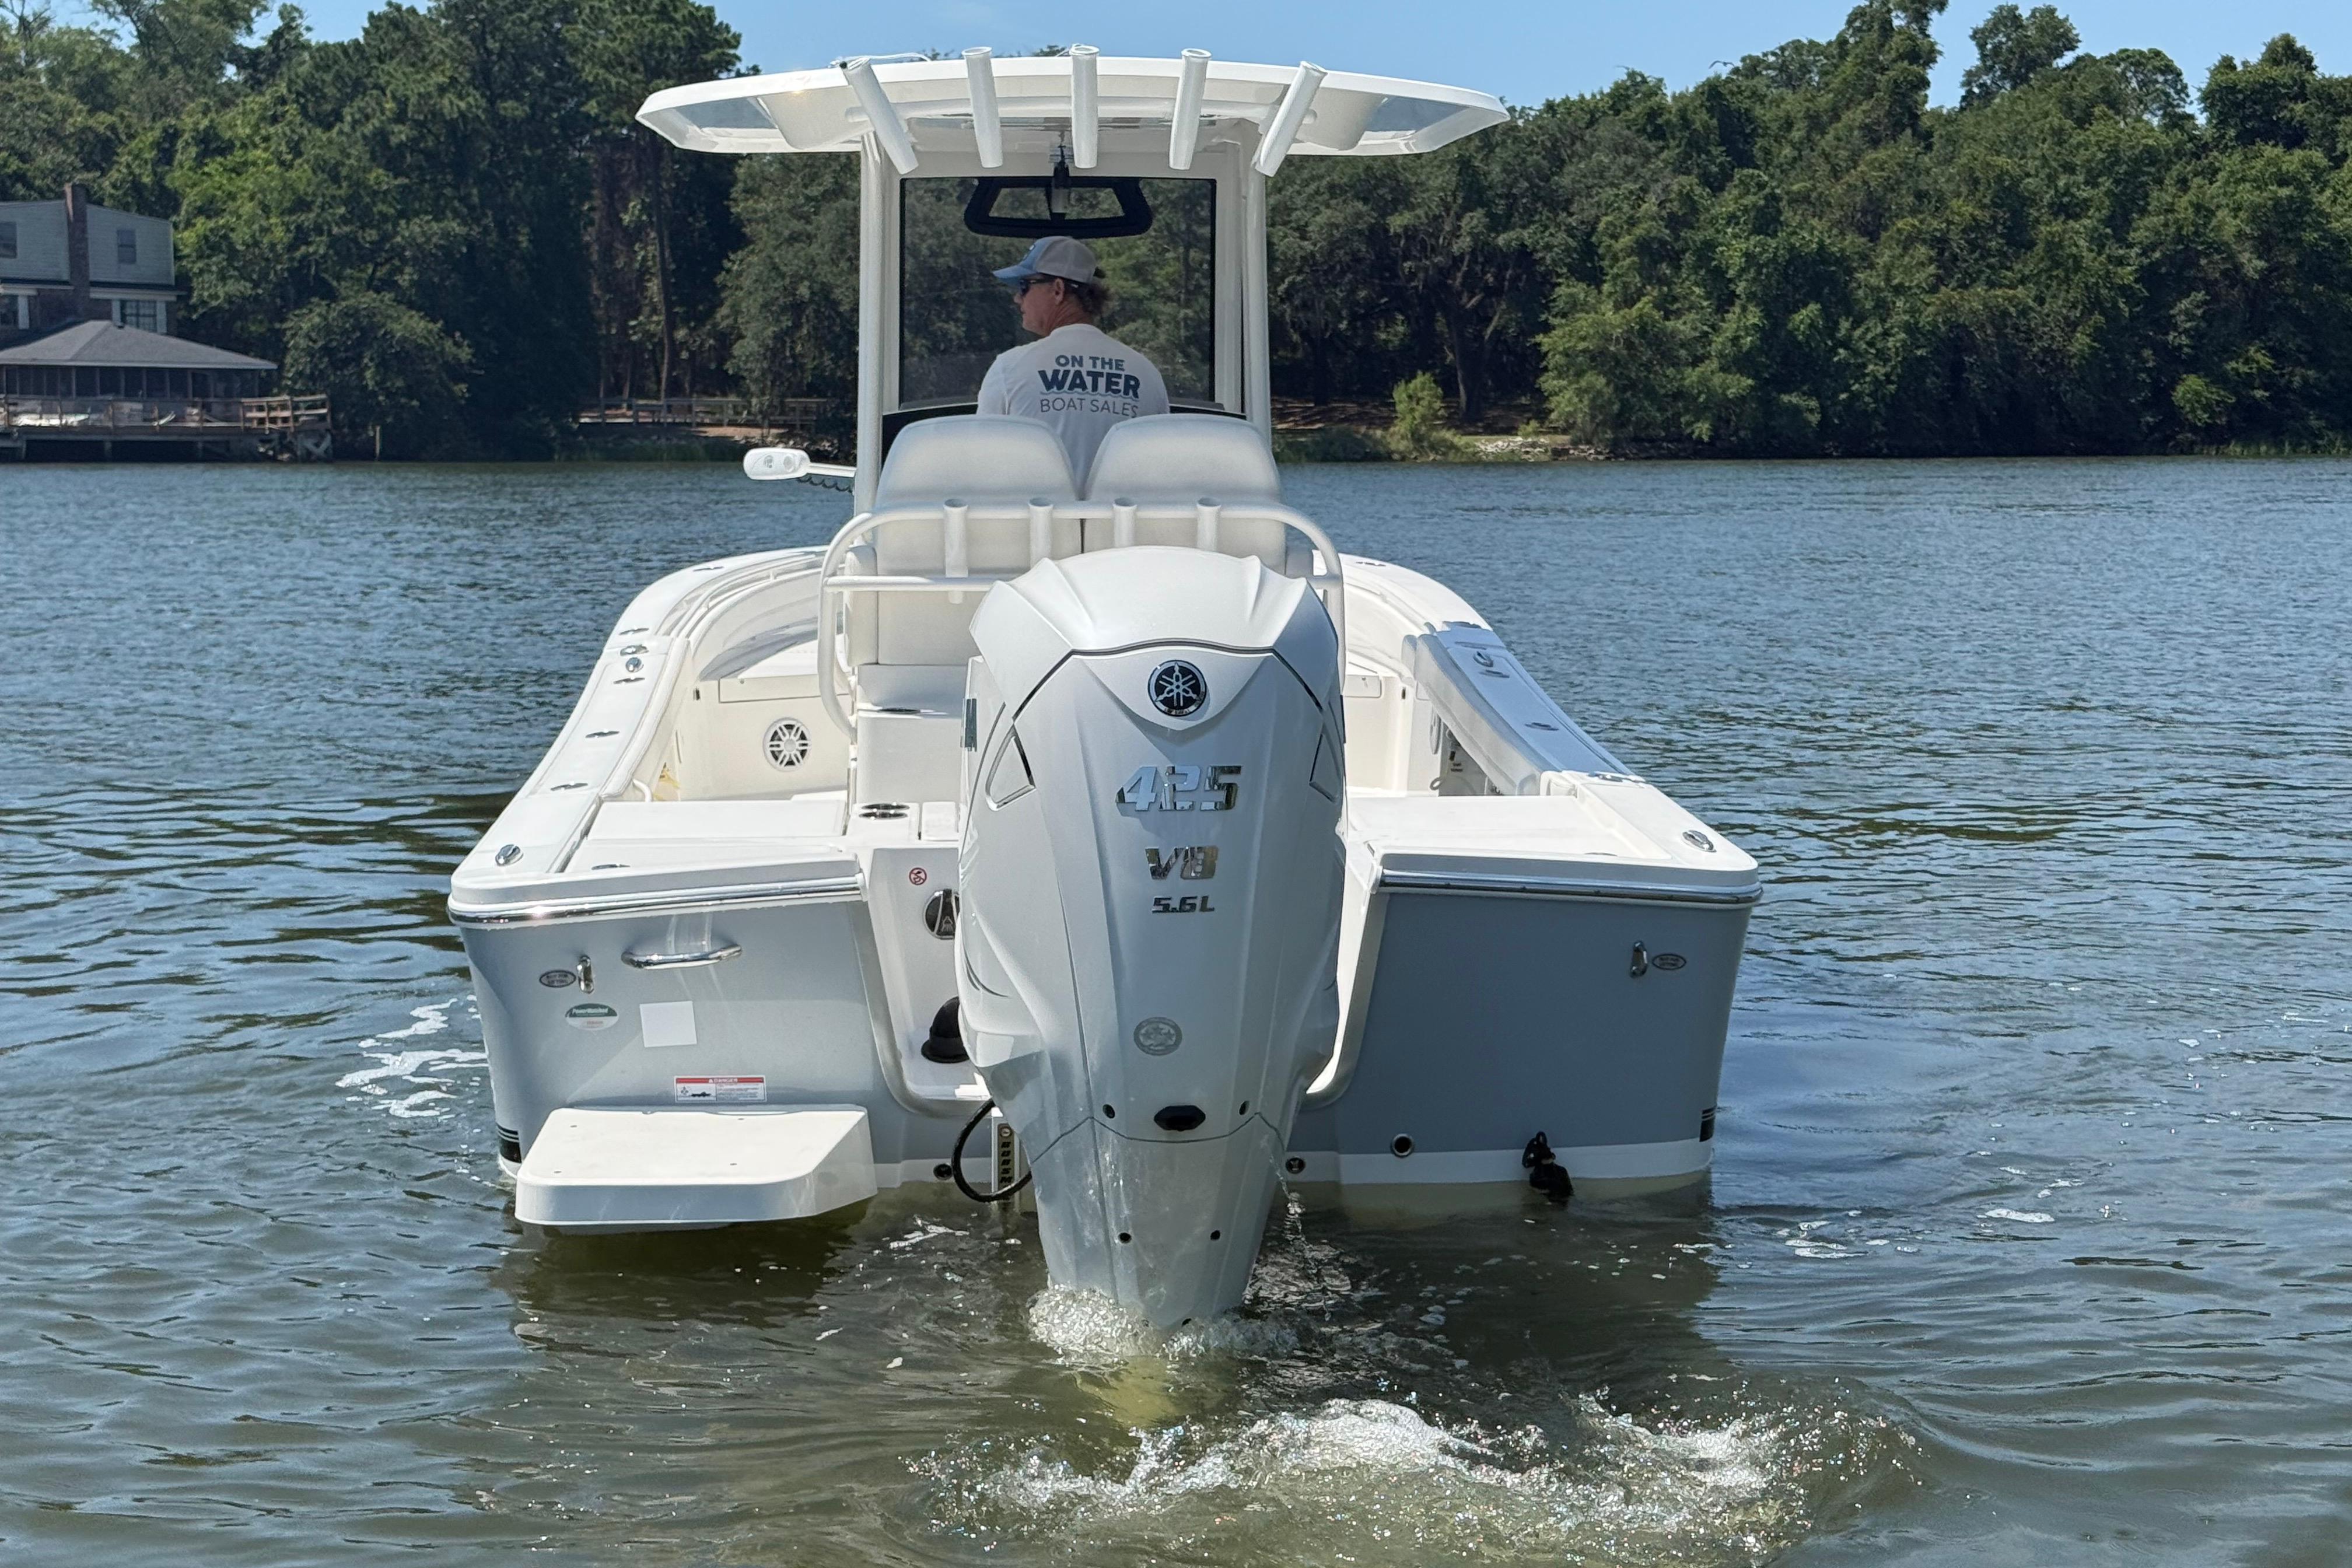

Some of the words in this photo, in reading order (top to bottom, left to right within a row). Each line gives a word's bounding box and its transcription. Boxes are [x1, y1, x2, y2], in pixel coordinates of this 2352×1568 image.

[1055, 354, 1084, 368] ON
[1088, 356, 1125, 372] THE
[1038, 369, 1140, 399] WATER
[1040, 397, 1086, 412] BOAT
[1090, 399, 1139, 418] SALES
[1115, 765, 1242, 811] 425
[1145, 846, 1219, 880] V8
[1152, 895, 1215, 914] 5.6L
